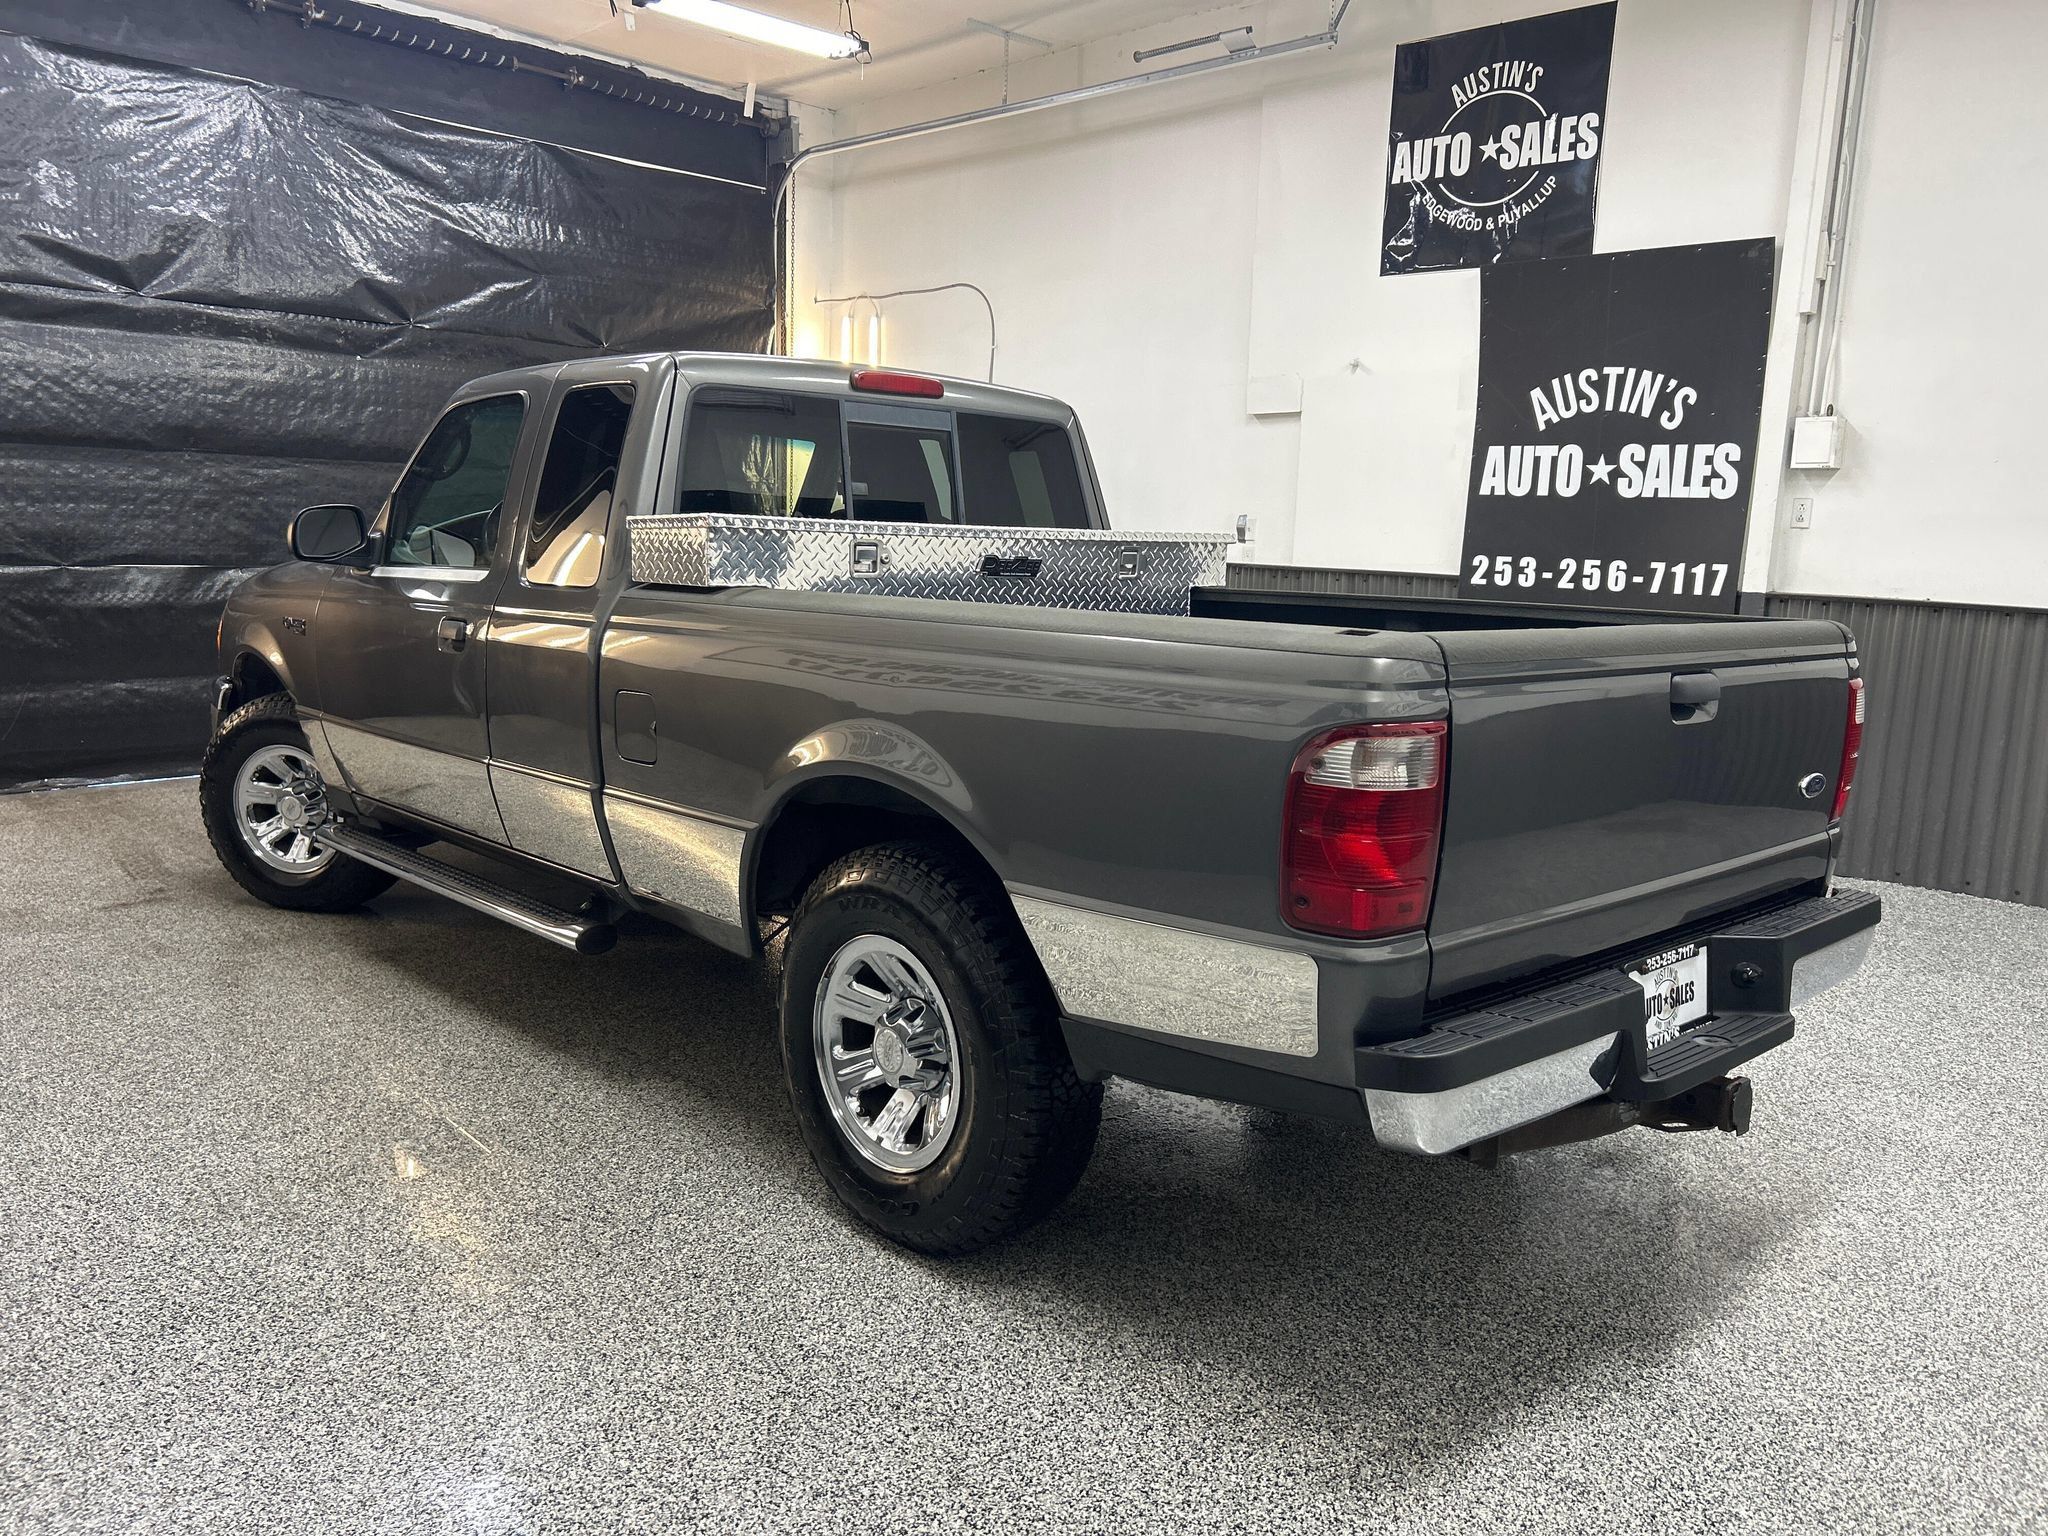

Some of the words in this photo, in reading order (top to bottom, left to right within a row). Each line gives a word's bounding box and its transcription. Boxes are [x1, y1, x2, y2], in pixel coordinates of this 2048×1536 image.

[1451, 60, 1544, 109] AUSTIN'S
[1391, 131, 1472, 184] AUTO
[1499, 112, 1600, 170] SALES
[1422, 191, 1483, 231] EDGEWOOD
[1486, 217, 1495, 230] &
[1498, 174, 1558, 228] PUYALLUP
[1529, 366, 1698, 431] AUSTIN'S
[1478, 444, 1584, 497] AUTO
[1617, 442, 1742, 500] SALES
[1470, 554, 1729, 597] 253-256-7117
[1646, 992, 1663, 1019] UTO
[1669, 980, 1695, 1010] SALES
